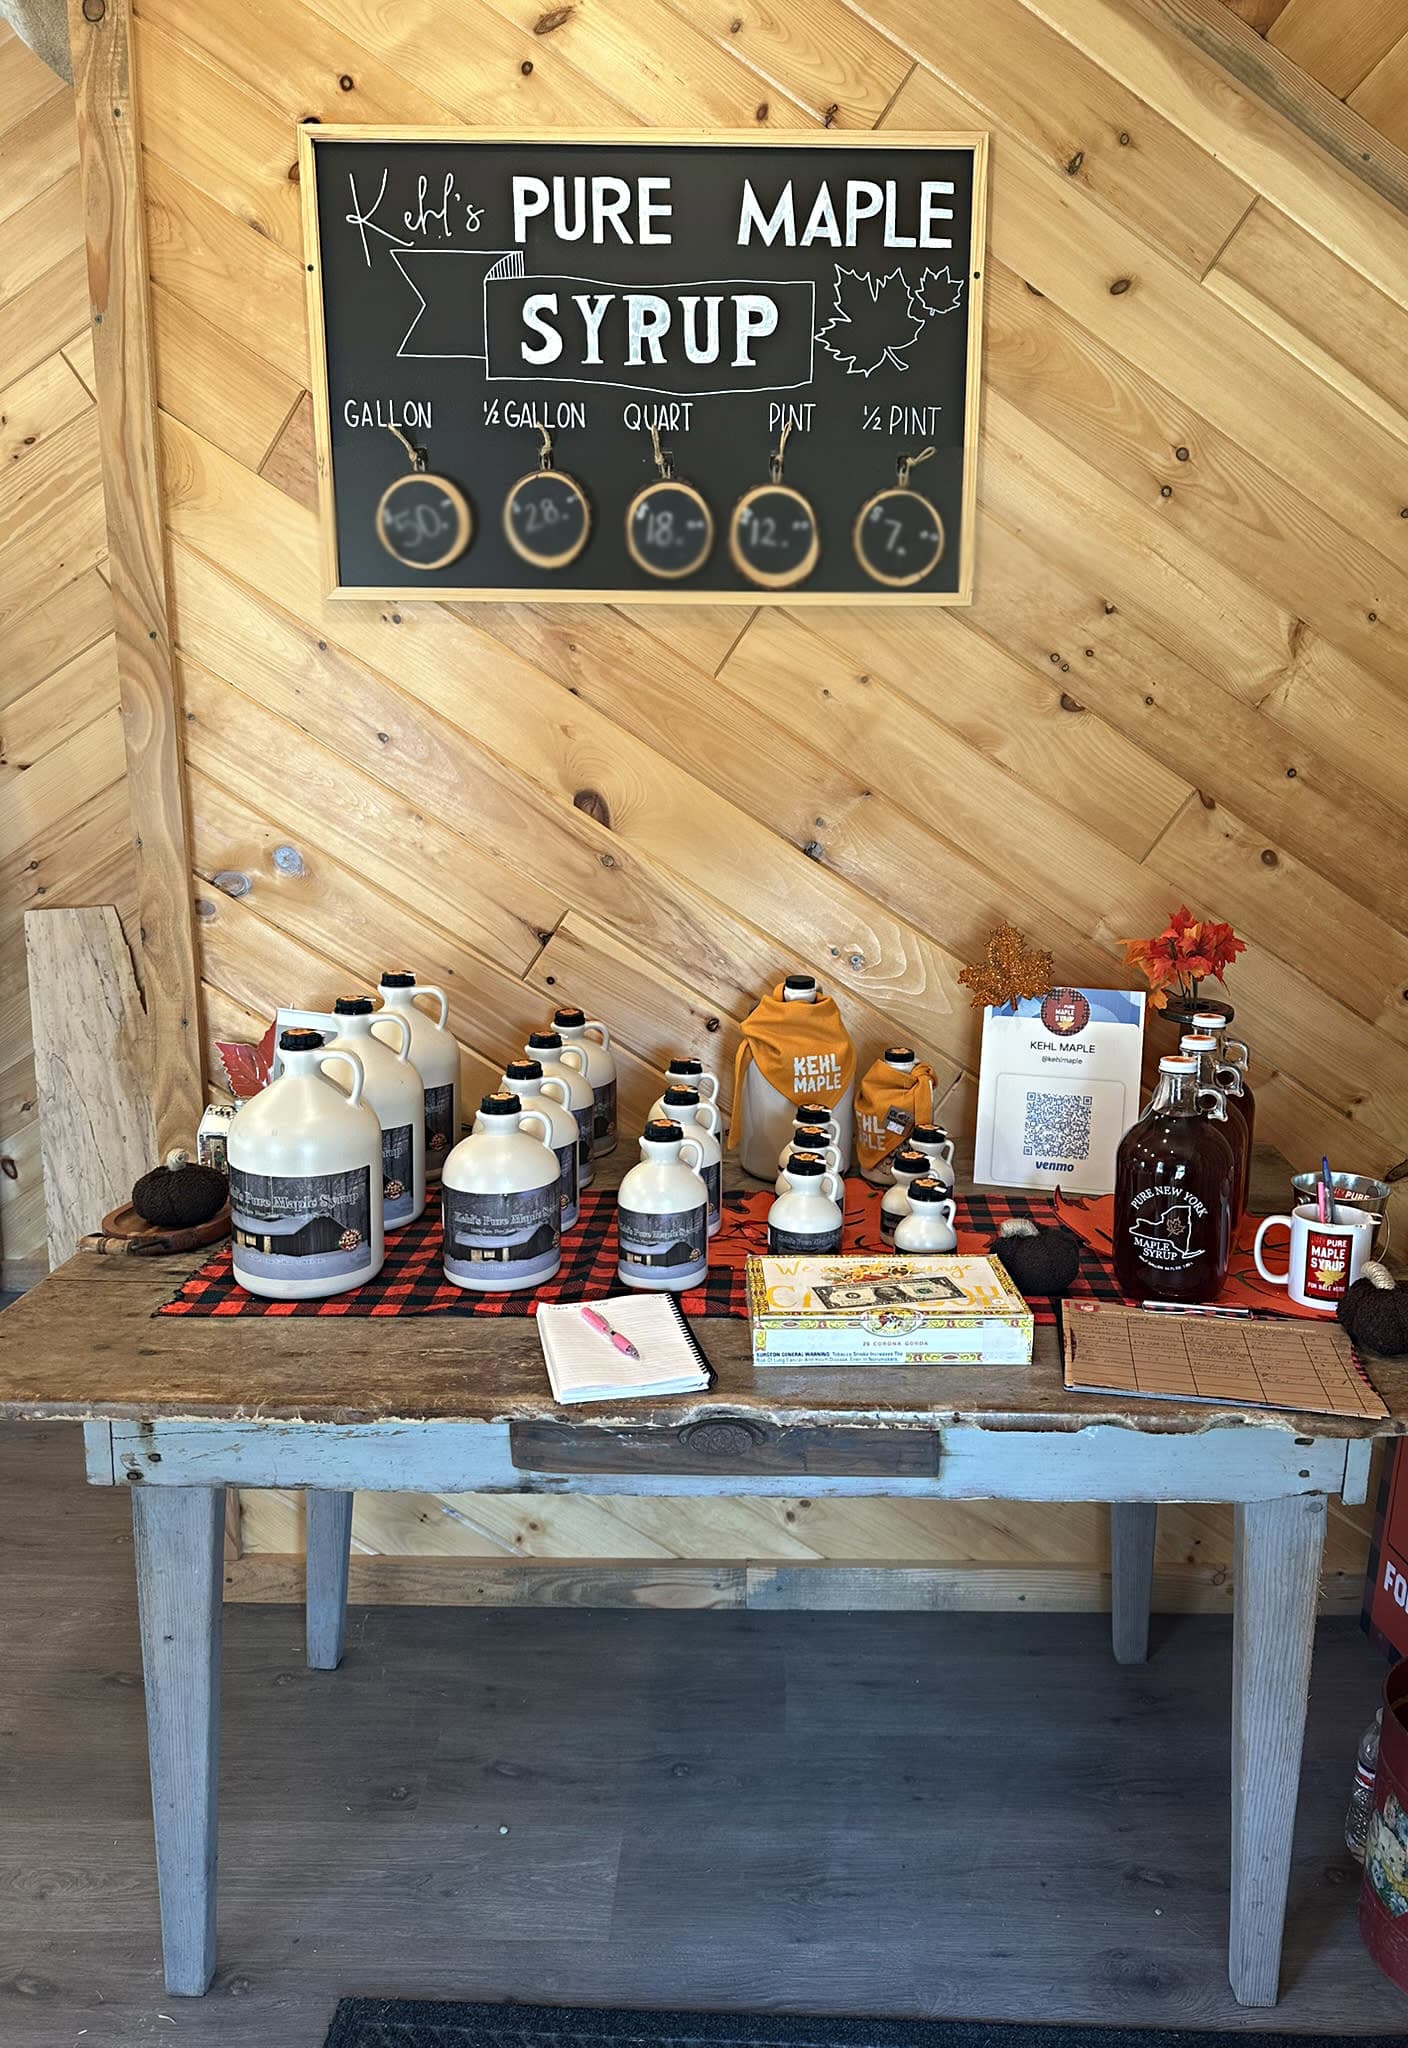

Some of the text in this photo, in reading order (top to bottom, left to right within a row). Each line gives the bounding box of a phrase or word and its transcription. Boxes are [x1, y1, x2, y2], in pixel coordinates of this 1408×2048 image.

[346, 168, 955, 267] Kehl's PURE MAPLE
[521, 294, 778, 367] SYRUP
[344, 400, 431, 428] GALLON
[623, 402, 694, 432] QUART
[769, 403, 816, 432] PINT
[889, 405, 942, 435] PINT
[1030, 1041, 1096, 1054] KEHL MAPLE
[793, 1053, 841, 1076] KEHL
[793, 1073, 842, 1093] MAPLE
[1036, 1161, 1075, 1172] venmo
[273, 1195, 317, 1212] Maple
[320, 1193, 359, 1210] Syrup
[1130, 1186, 1208, 1218] PURE NEW YORK
[1344, 1190, 1371, 1200] PURE
[1133, 1237, 1170, 1252] MAPLE
[1312, 1245, 1346, 1260] MAPLE
[1327, 1239, 1347, 1248] PURE
[1142, 1248, 1177, 1260] SYRUP
[775, 1260, 813, 1276] We
[1310, 1257, 1345, 1272] SYRUP
[1383, 1560, 1408, 1616] FO
